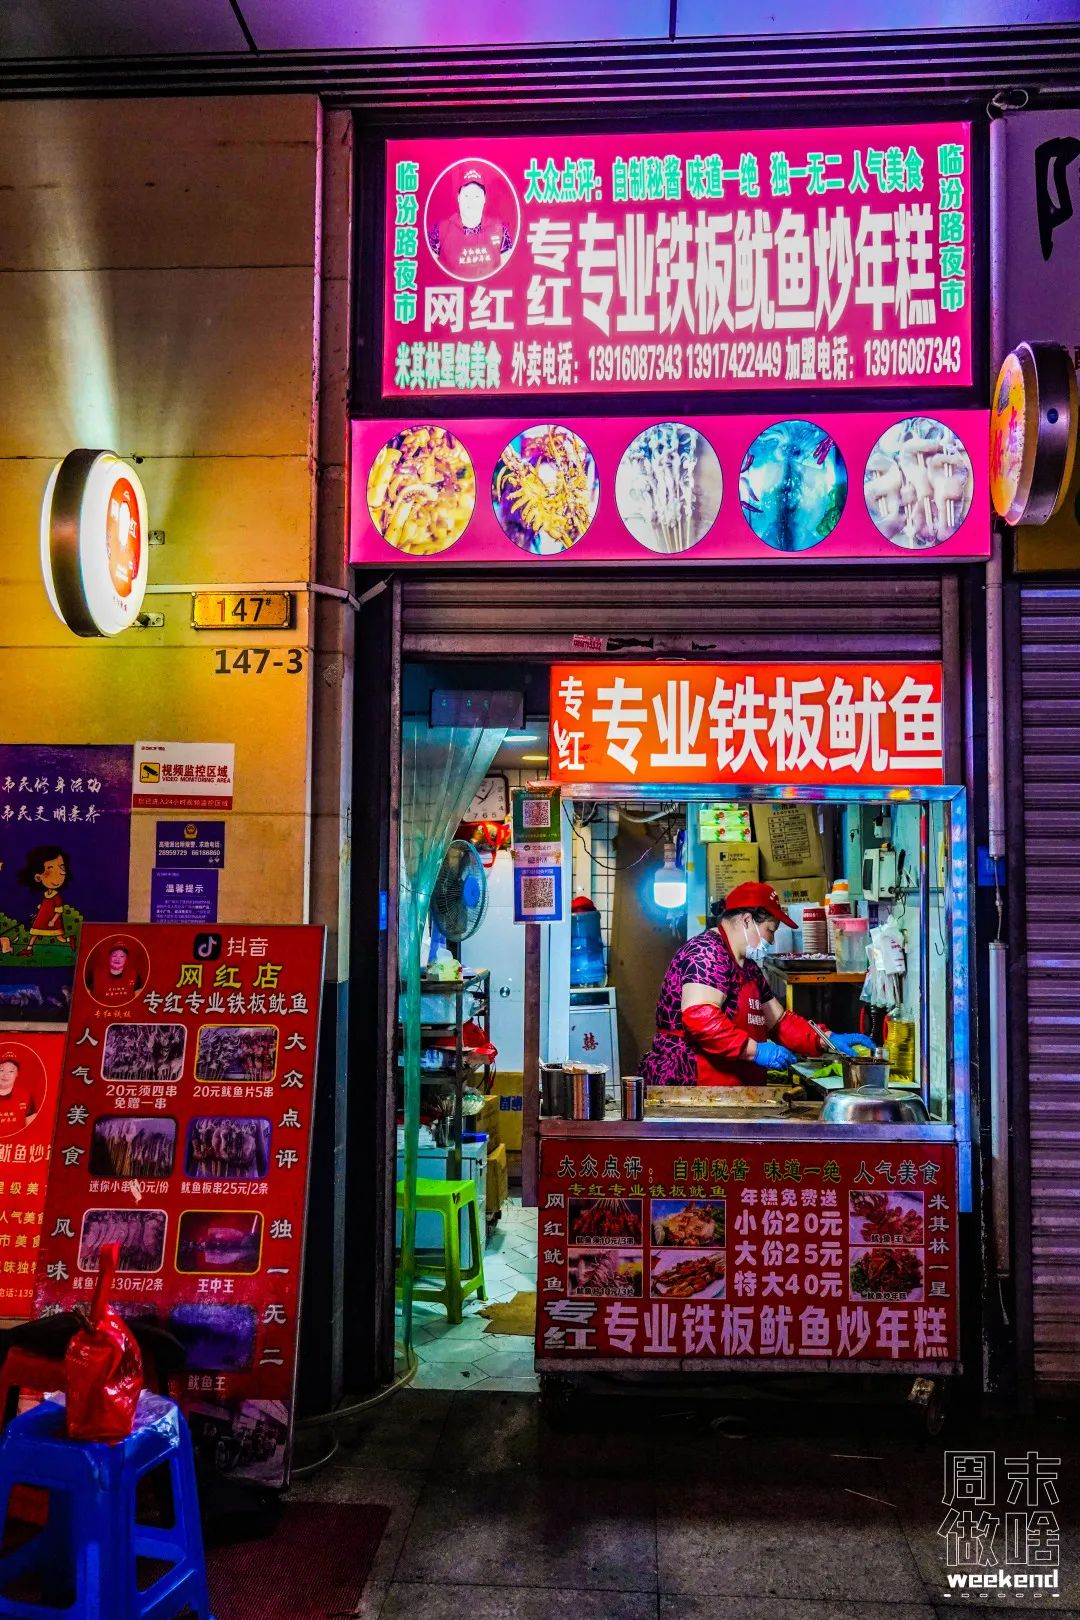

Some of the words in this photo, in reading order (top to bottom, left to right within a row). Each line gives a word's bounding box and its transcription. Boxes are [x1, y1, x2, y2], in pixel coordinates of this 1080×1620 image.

[525, 157, 602, 203] 大众点评：
[612, 155, 682, 202] 自制秘酱
[686, 153, 759, 200] 味道一绝
[770, 150, 844, 197] 独一无二
[849, 146, 924, 194] 人气美食
[937, 143, 964, 312] 临汾路夜市
[394, 160, 419, 324] 临汾路夜市
[527, 217, 573, 327] 专红
[577, 203, 936, 337] 专业铁板鱿鱼炒年糕
[424, 286, 515, 332] 网红
[394, 340, 502, 390] 米其林星级美食
[511, 340, 578, 387] 外卖电话：
[588, 344, 682, 381] 13916087343
[686, 340, 782, 379] 13917422449
[785, 335, 854, 381] 加盟电话：
[864, 335, 961, 376] 13916087343
[215, 648, 303, 675] 147-3
[554, 675, 585, 771] 专红
[592, 675, 942, 774] 专业铁板鱿鱼
[162, 764, 228, 778] 视频监控区域
[165, 884, 204, 894] 温馨提示
[227, 936, 269, 958] 抖音
[176, 963, 283, 990] 网红店
[143, 991, 309, 1016] 专红专业铁板鱿鱼
[61, 1027, 99, 1166] 人气美食
[105, 1084, 178, 1098] 20元须四串
[114, 1097, 167, 1110] 免赠一串
[193, 1085, 274, 1099] 20元鱿鱼片5串
[275, 1032, 307, 1169] 大众点评
[557, 1155, 653, 1184] 大众点评：
[672, 1157, 750, 1183] 自制秘酱
[763, 1159, 842, 1183] 味道一绝
[854, 1159, 940, 1186] 人气美食
[89, 1180, 169, 1194] 迷你小串0元/份
[181, 1181, 268, 1195] 鱿鱼板串25元/2条
[568, 1183, 728, 1199] 专红专业铁板鱿鱼
[740, 1187, 838, 1207] 年糕免费送
[734, 1211, 843, 1236] 小份20元
[734, 1241, 843, 1267] 大份25元
[197, 1278, 235, 1294] 王中王
[734, 1272, 843, 1298] 特大40元
[604, 1301, 949, 1359] 专业铁板鱿鱼炒年糕
[187, 1374, 226, 1392] 鱿鱼王
